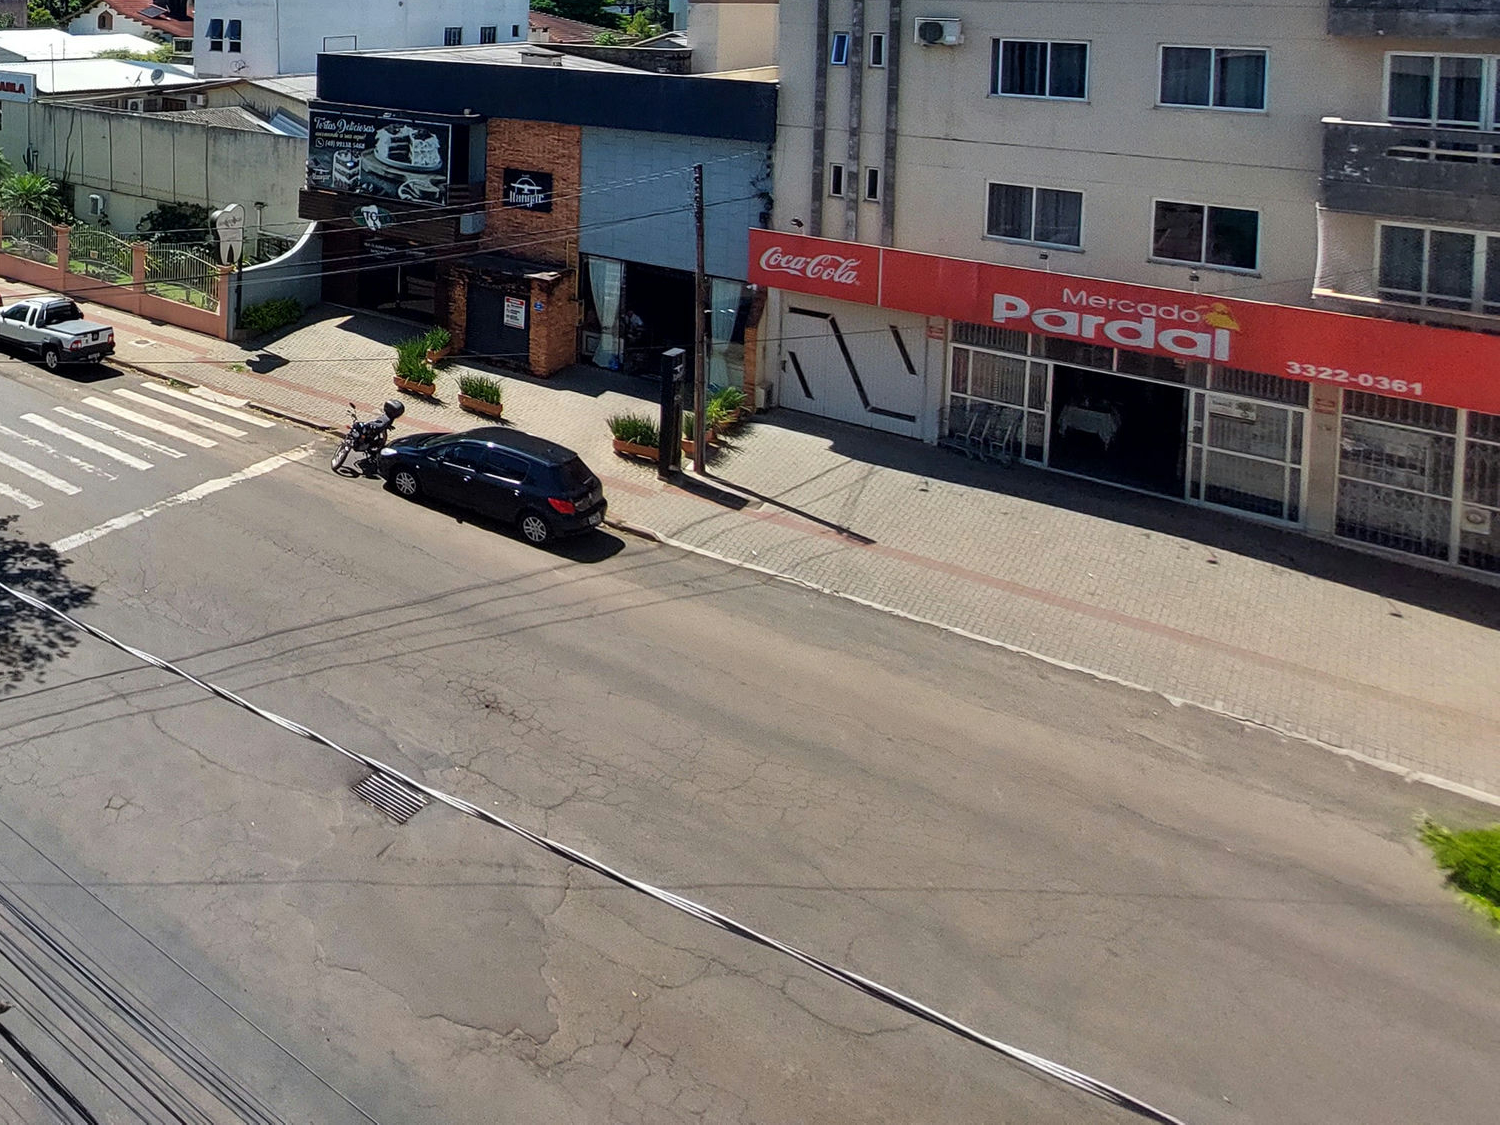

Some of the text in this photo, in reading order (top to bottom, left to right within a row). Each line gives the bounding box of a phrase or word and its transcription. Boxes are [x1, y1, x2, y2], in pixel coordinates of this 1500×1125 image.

[314, 117, 376, 133] Tortas Deliciosas
[760, 246, 861, 284] Coca-Cola
[1062, 288, 1201, 323] Mercado
[992, 293, 1231, 362] Pardal
[1285, 361, 1424, 396] 3322-0361
